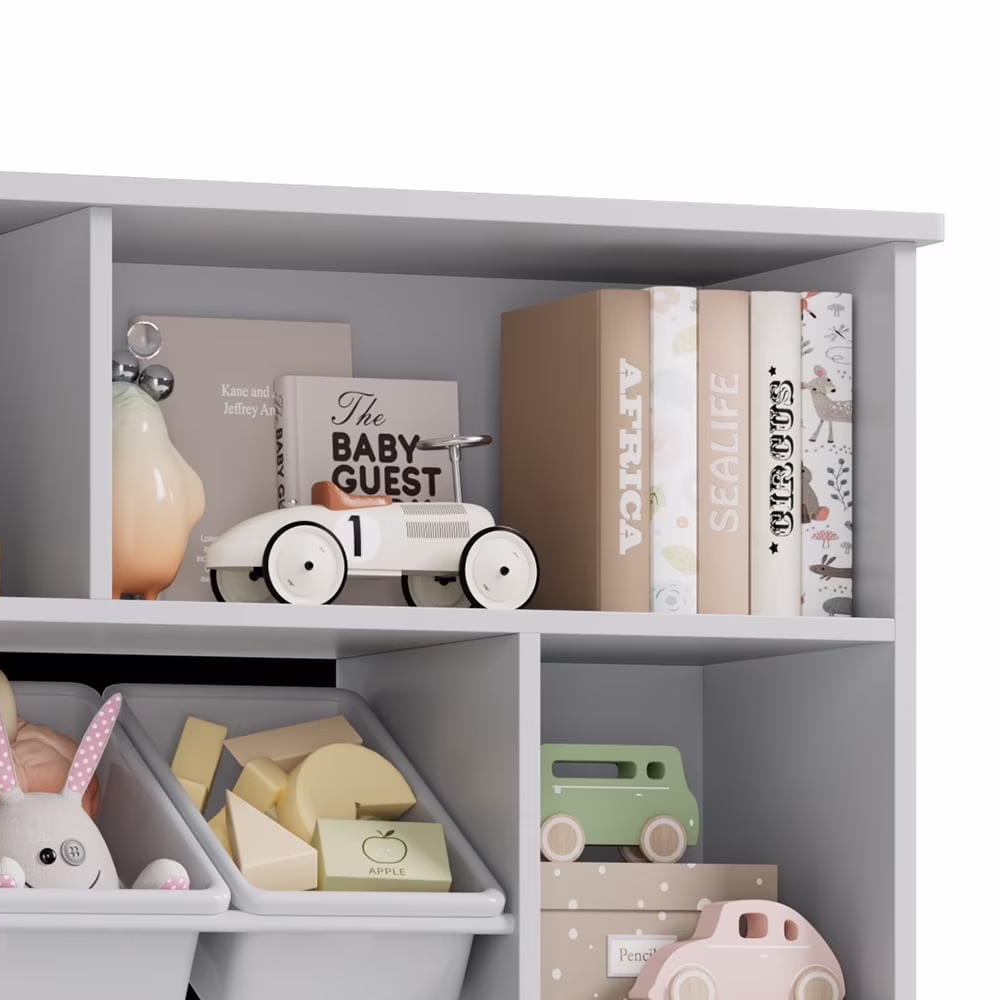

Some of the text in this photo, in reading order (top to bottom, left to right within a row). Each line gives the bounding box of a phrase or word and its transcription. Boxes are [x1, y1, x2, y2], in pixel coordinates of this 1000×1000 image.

[221, 383, 249, 398] Kane
[250, 384, 270, 398] and
[223, 401, 259, 418] Jeffrey
[331, 391, 387, 426] The
[276, 427, 286, 478] BABY
[332, 432, 420, 464] BABY
[620, 358, 643, 555] AFRICA
[709, 371, 740, 534] SEALIFE
[769, 379, 795, 537] CIRCUS
[331, 464, 442, 497] GUEST
[348, 515, 362, 557] 1
[368, 867, 407, 877] APPLE
[619, 947, 657, 962] Penci
